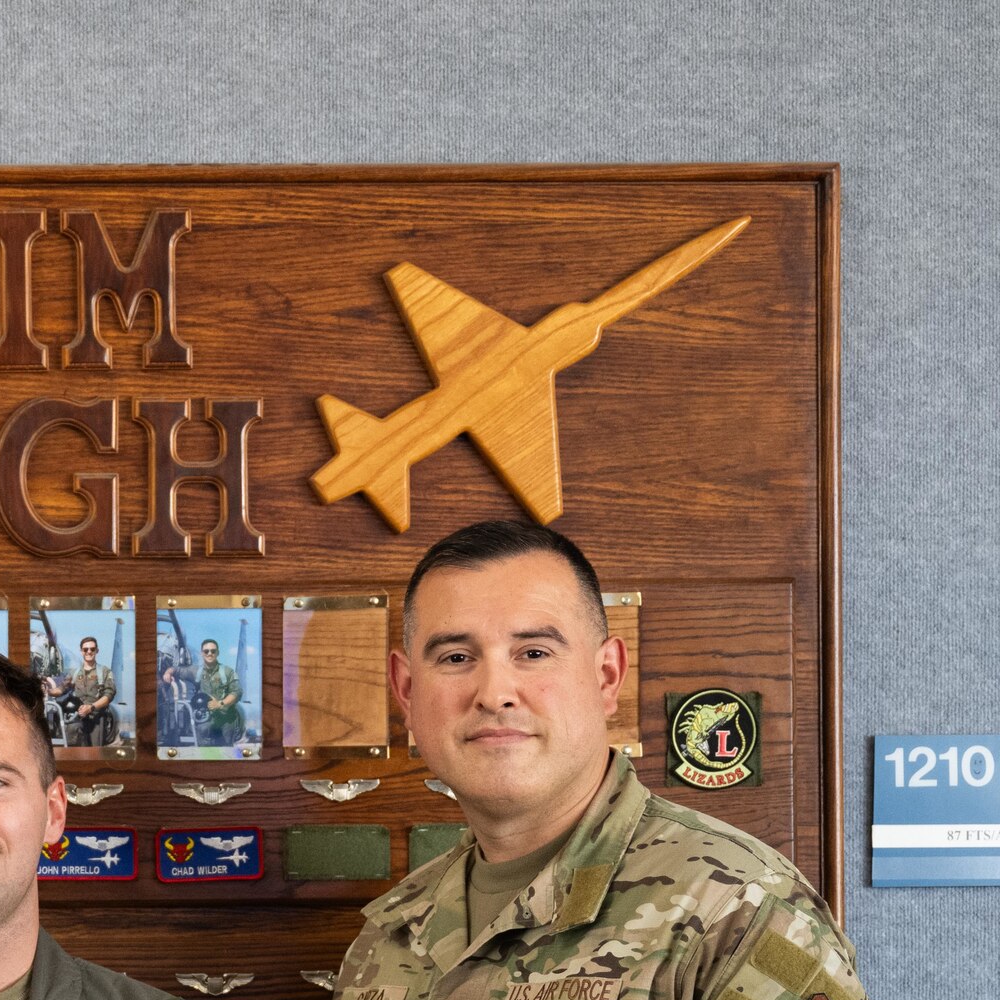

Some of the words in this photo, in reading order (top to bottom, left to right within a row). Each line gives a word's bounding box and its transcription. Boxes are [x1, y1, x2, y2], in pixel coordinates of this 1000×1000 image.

[715, 730, 739, 757] L
[884, 745, 995, 788] 1210
[682, 767, 745, 786] LIZARDS
[946, 830, 961, 841] 87
[37, 866, 59, 875] JOHN
[61, 866, 100, 875] PIRRELLO
[171, 866, 194, 876] CHAD
[197, 865, 228, 875] WILDER
[558, 978, 614, 1000] FORCE
